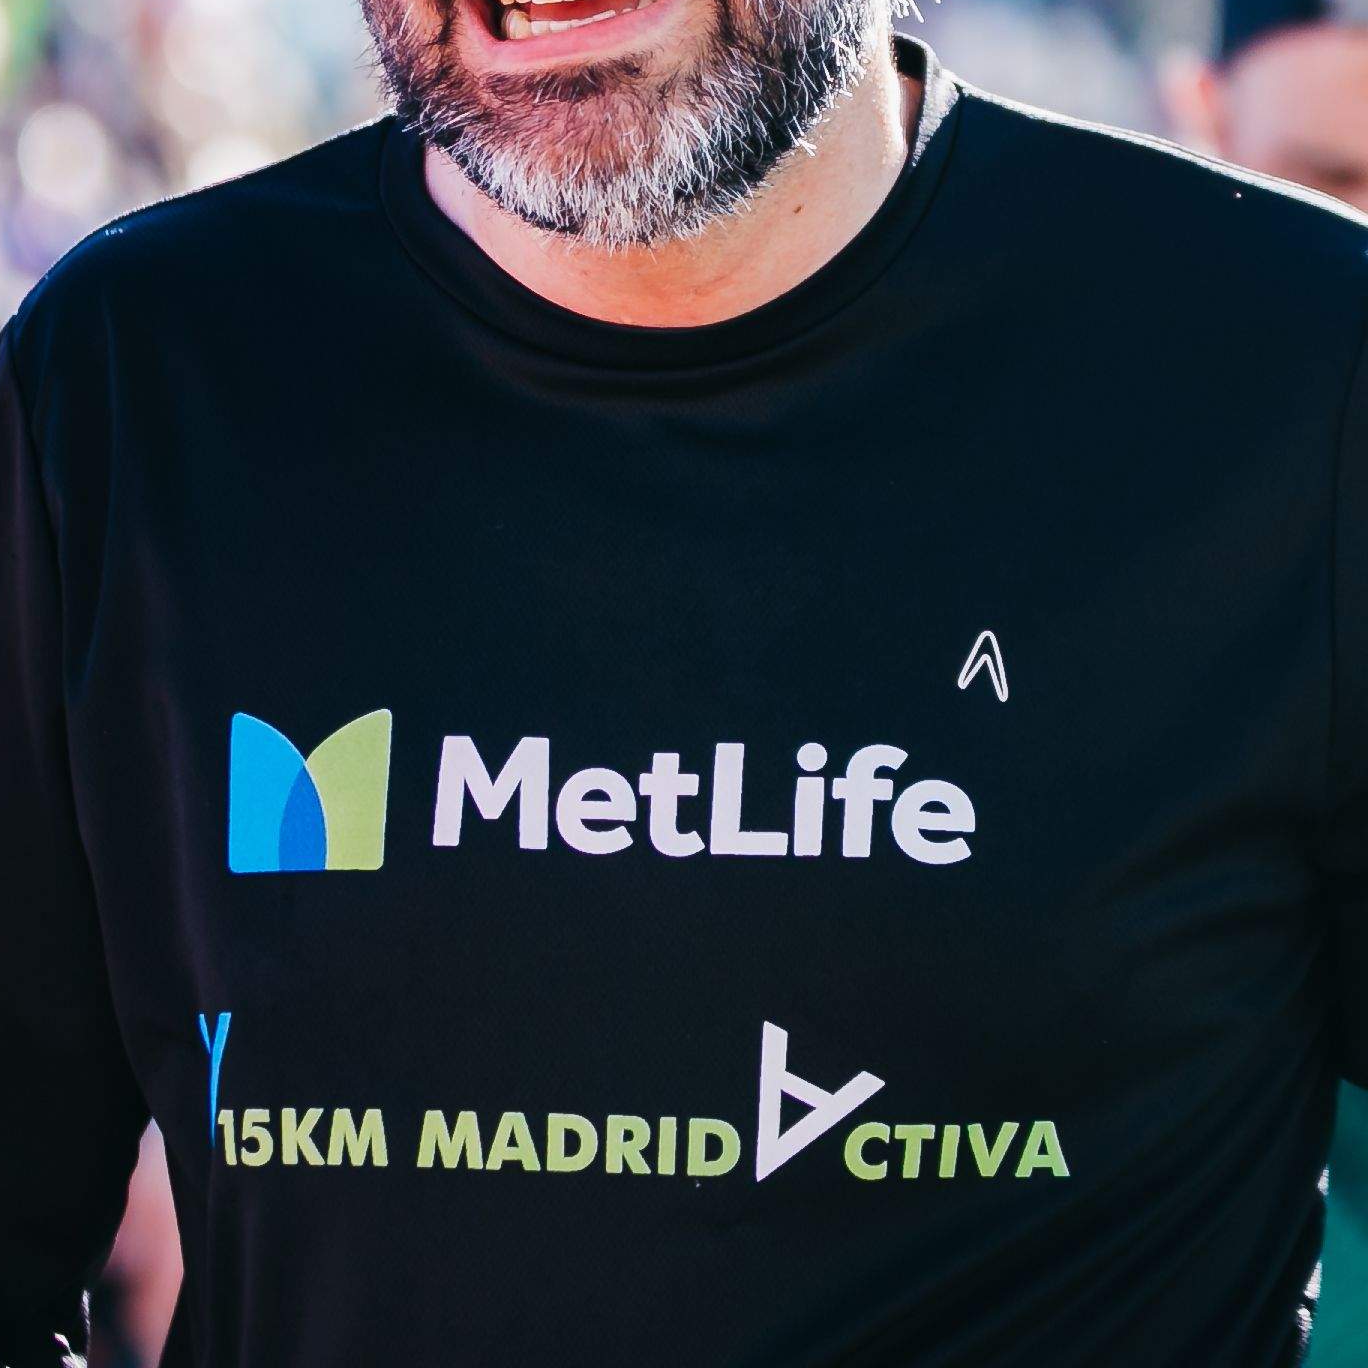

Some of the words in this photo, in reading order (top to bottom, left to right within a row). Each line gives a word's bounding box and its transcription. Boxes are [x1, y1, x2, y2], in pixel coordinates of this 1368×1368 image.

[432, 735, 976, 865] MetLife
[217, 1107, 389, 1167] 15KM
[416, 1109, 742, 1178] MADRID
